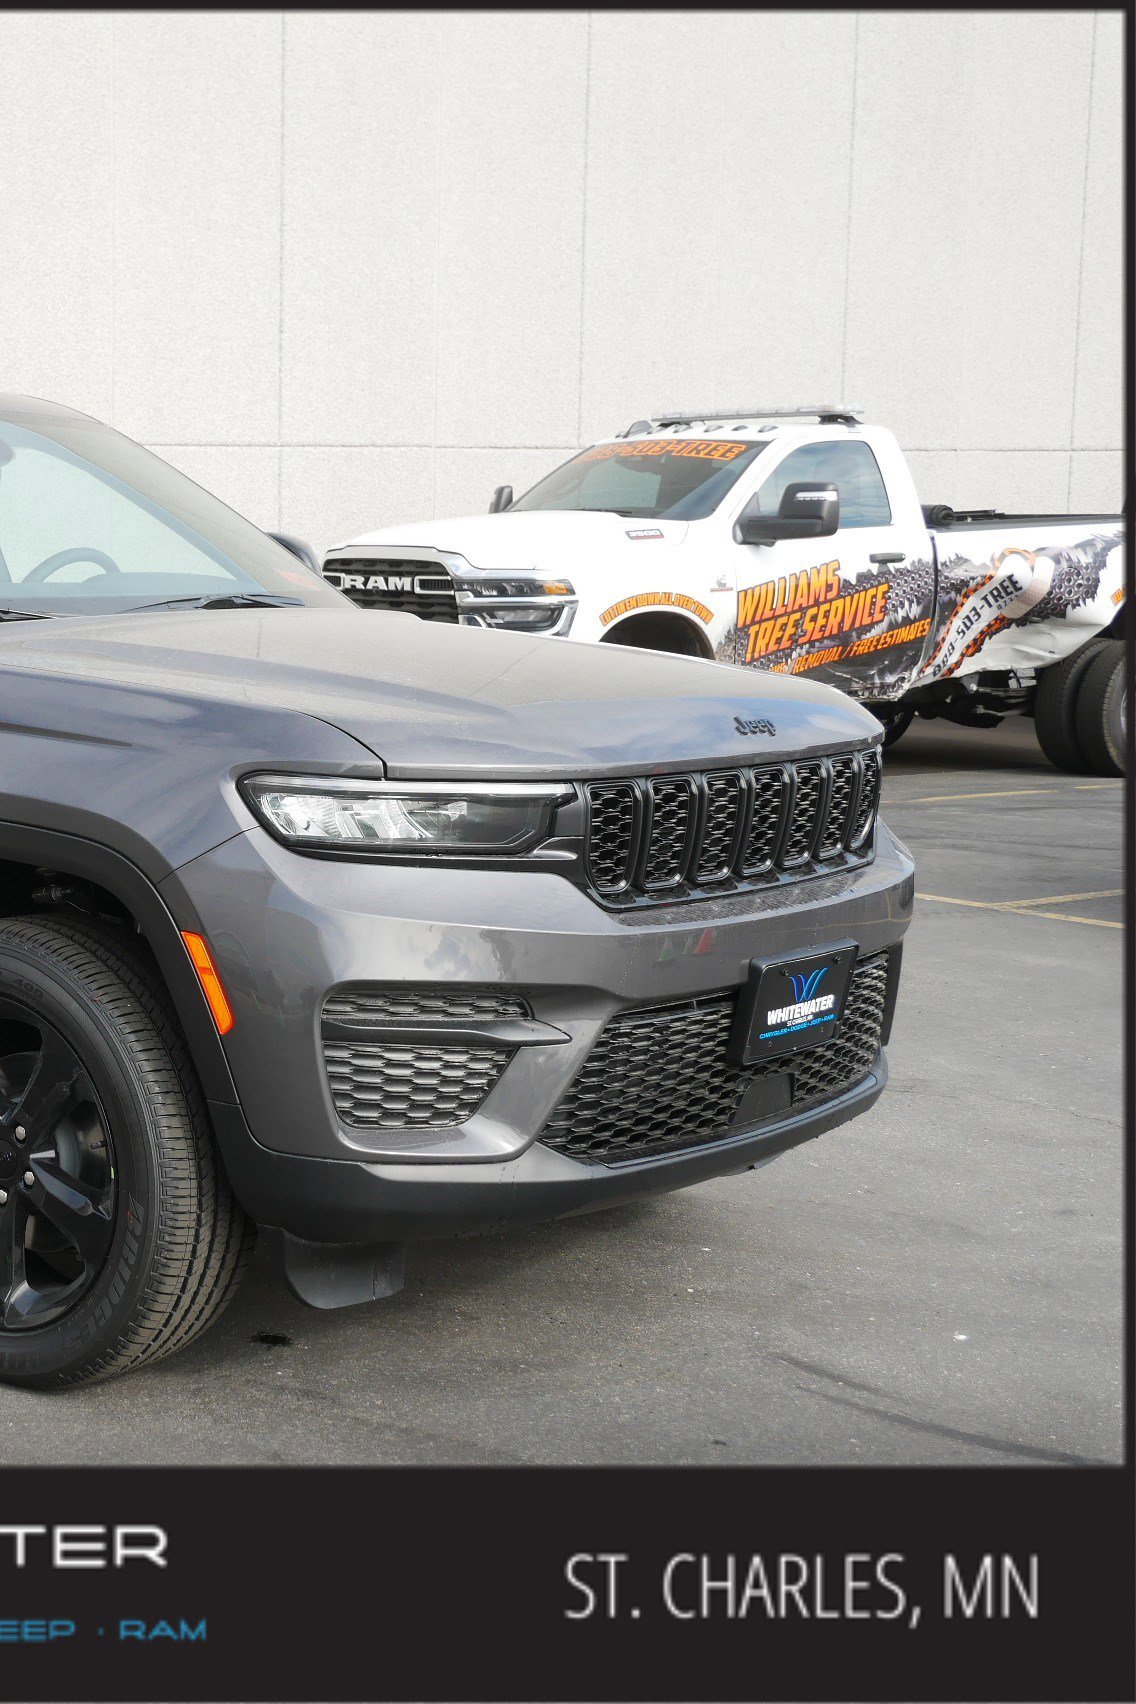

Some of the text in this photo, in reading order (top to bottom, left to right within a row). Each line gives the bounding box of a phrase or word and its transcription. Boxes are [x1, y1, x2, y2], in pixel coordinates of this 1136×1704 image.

[343, 574, 413, 592] RAM
[737, 558, 841, 629] WILLIAMS
[637, 592, 661, 606] DOWN
[660, 592, 674, 606] ALL
[673, 593, 694, 611] OVER
[692, 600, 714, 626] TOWN
[746, 611, 803, 663] TREE
[798, 582, 891, 645] SERVICE
[851, 635, 880, 657] FREE
[877, 617, 933, 650] ESTIMATES
[733, 716, 776, 738] Jeep
[767, 994, 835, 1025] WHITEWATER
[823, 1013, 835, 1021] RAM
